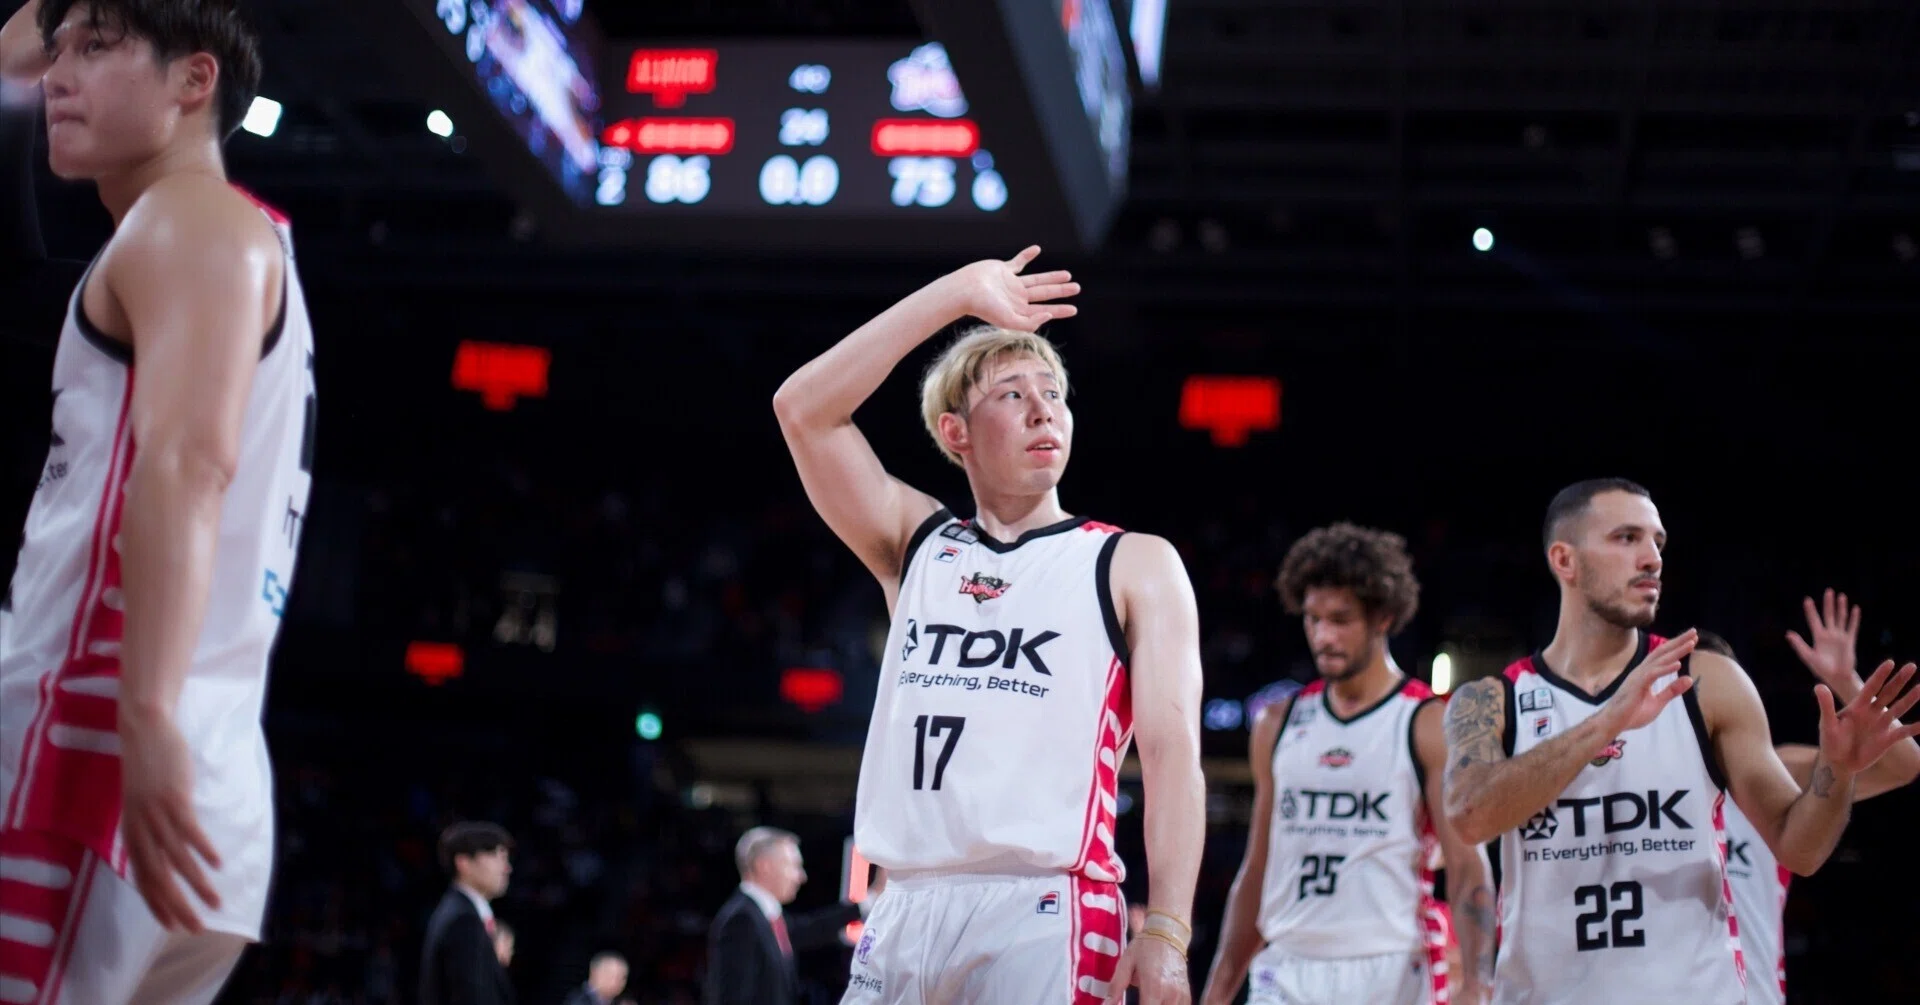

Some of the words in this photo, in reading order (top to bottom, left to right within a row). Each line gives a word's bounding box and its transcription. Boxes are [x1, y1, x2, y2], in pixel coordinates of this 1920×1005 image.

[645, 154, 711, 204] 86
[924, 623, 1062, 676] TDK
[987, 676, 1049, 698] Better
[913, 714, 966, 791] 17
[1300, 790, 1391, 822] TDK
[1557, 789, 1694, 837] TDK
[1524, 848, 1538, 862] In
[1542, 842, 1638, 862] Everything,
[1642, 837, 1696, 852] Better
[1299, 855, 1346, 902] 25
[1574, 880, 1646, 952] 22
